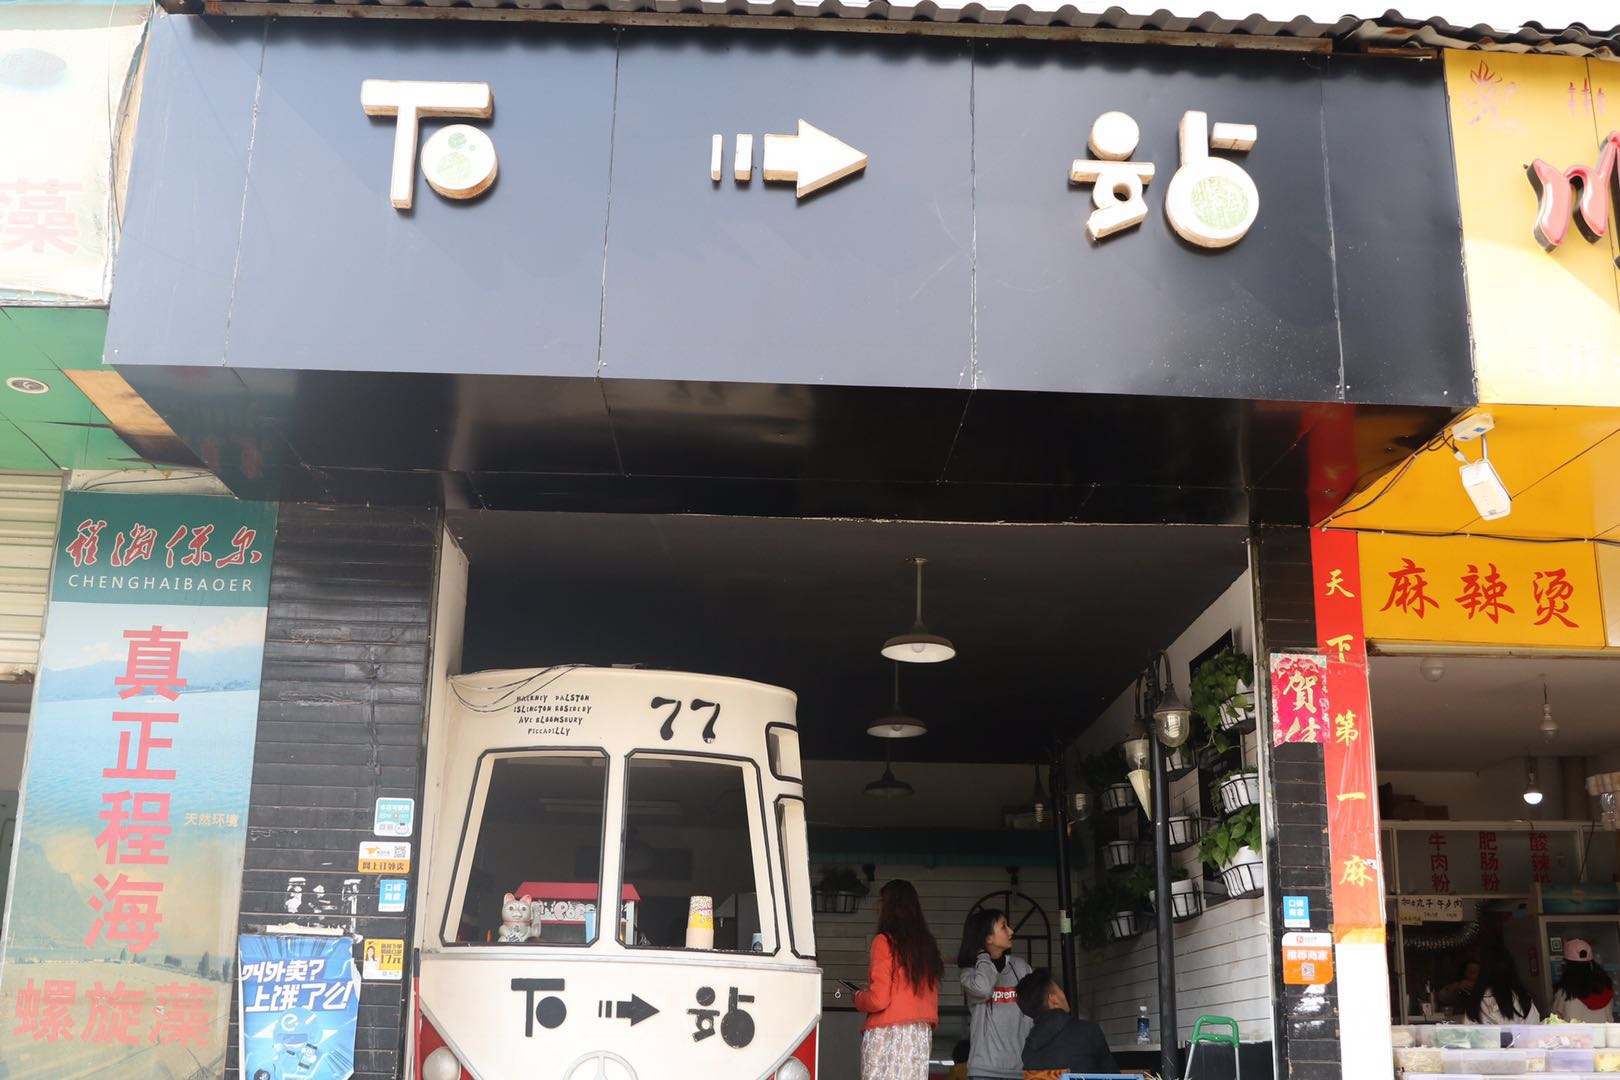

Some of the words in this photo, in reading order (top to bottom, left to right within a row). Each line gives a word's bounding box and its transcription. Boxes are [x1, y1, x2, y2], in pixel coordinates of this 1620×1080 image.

[68, 574, 253, 592] CHENGHAIBAOER
[1379, 558, 1580, 628] 麻辣烫
[555, 693, 590, 702] DALSTON
[650, 696, 721, 743] 77
[527, 727, 571, 736] PICCADILLY
[83, 624, 189, 954] 真正程海
[1428, 832, 1450, 892] 牛肉粉
[1478, 831, 1500, 891] 肥肠粉
[241, 959, 325, 982] 叫外卖?
[12, 977, 214, 1047] 螺旋藻
